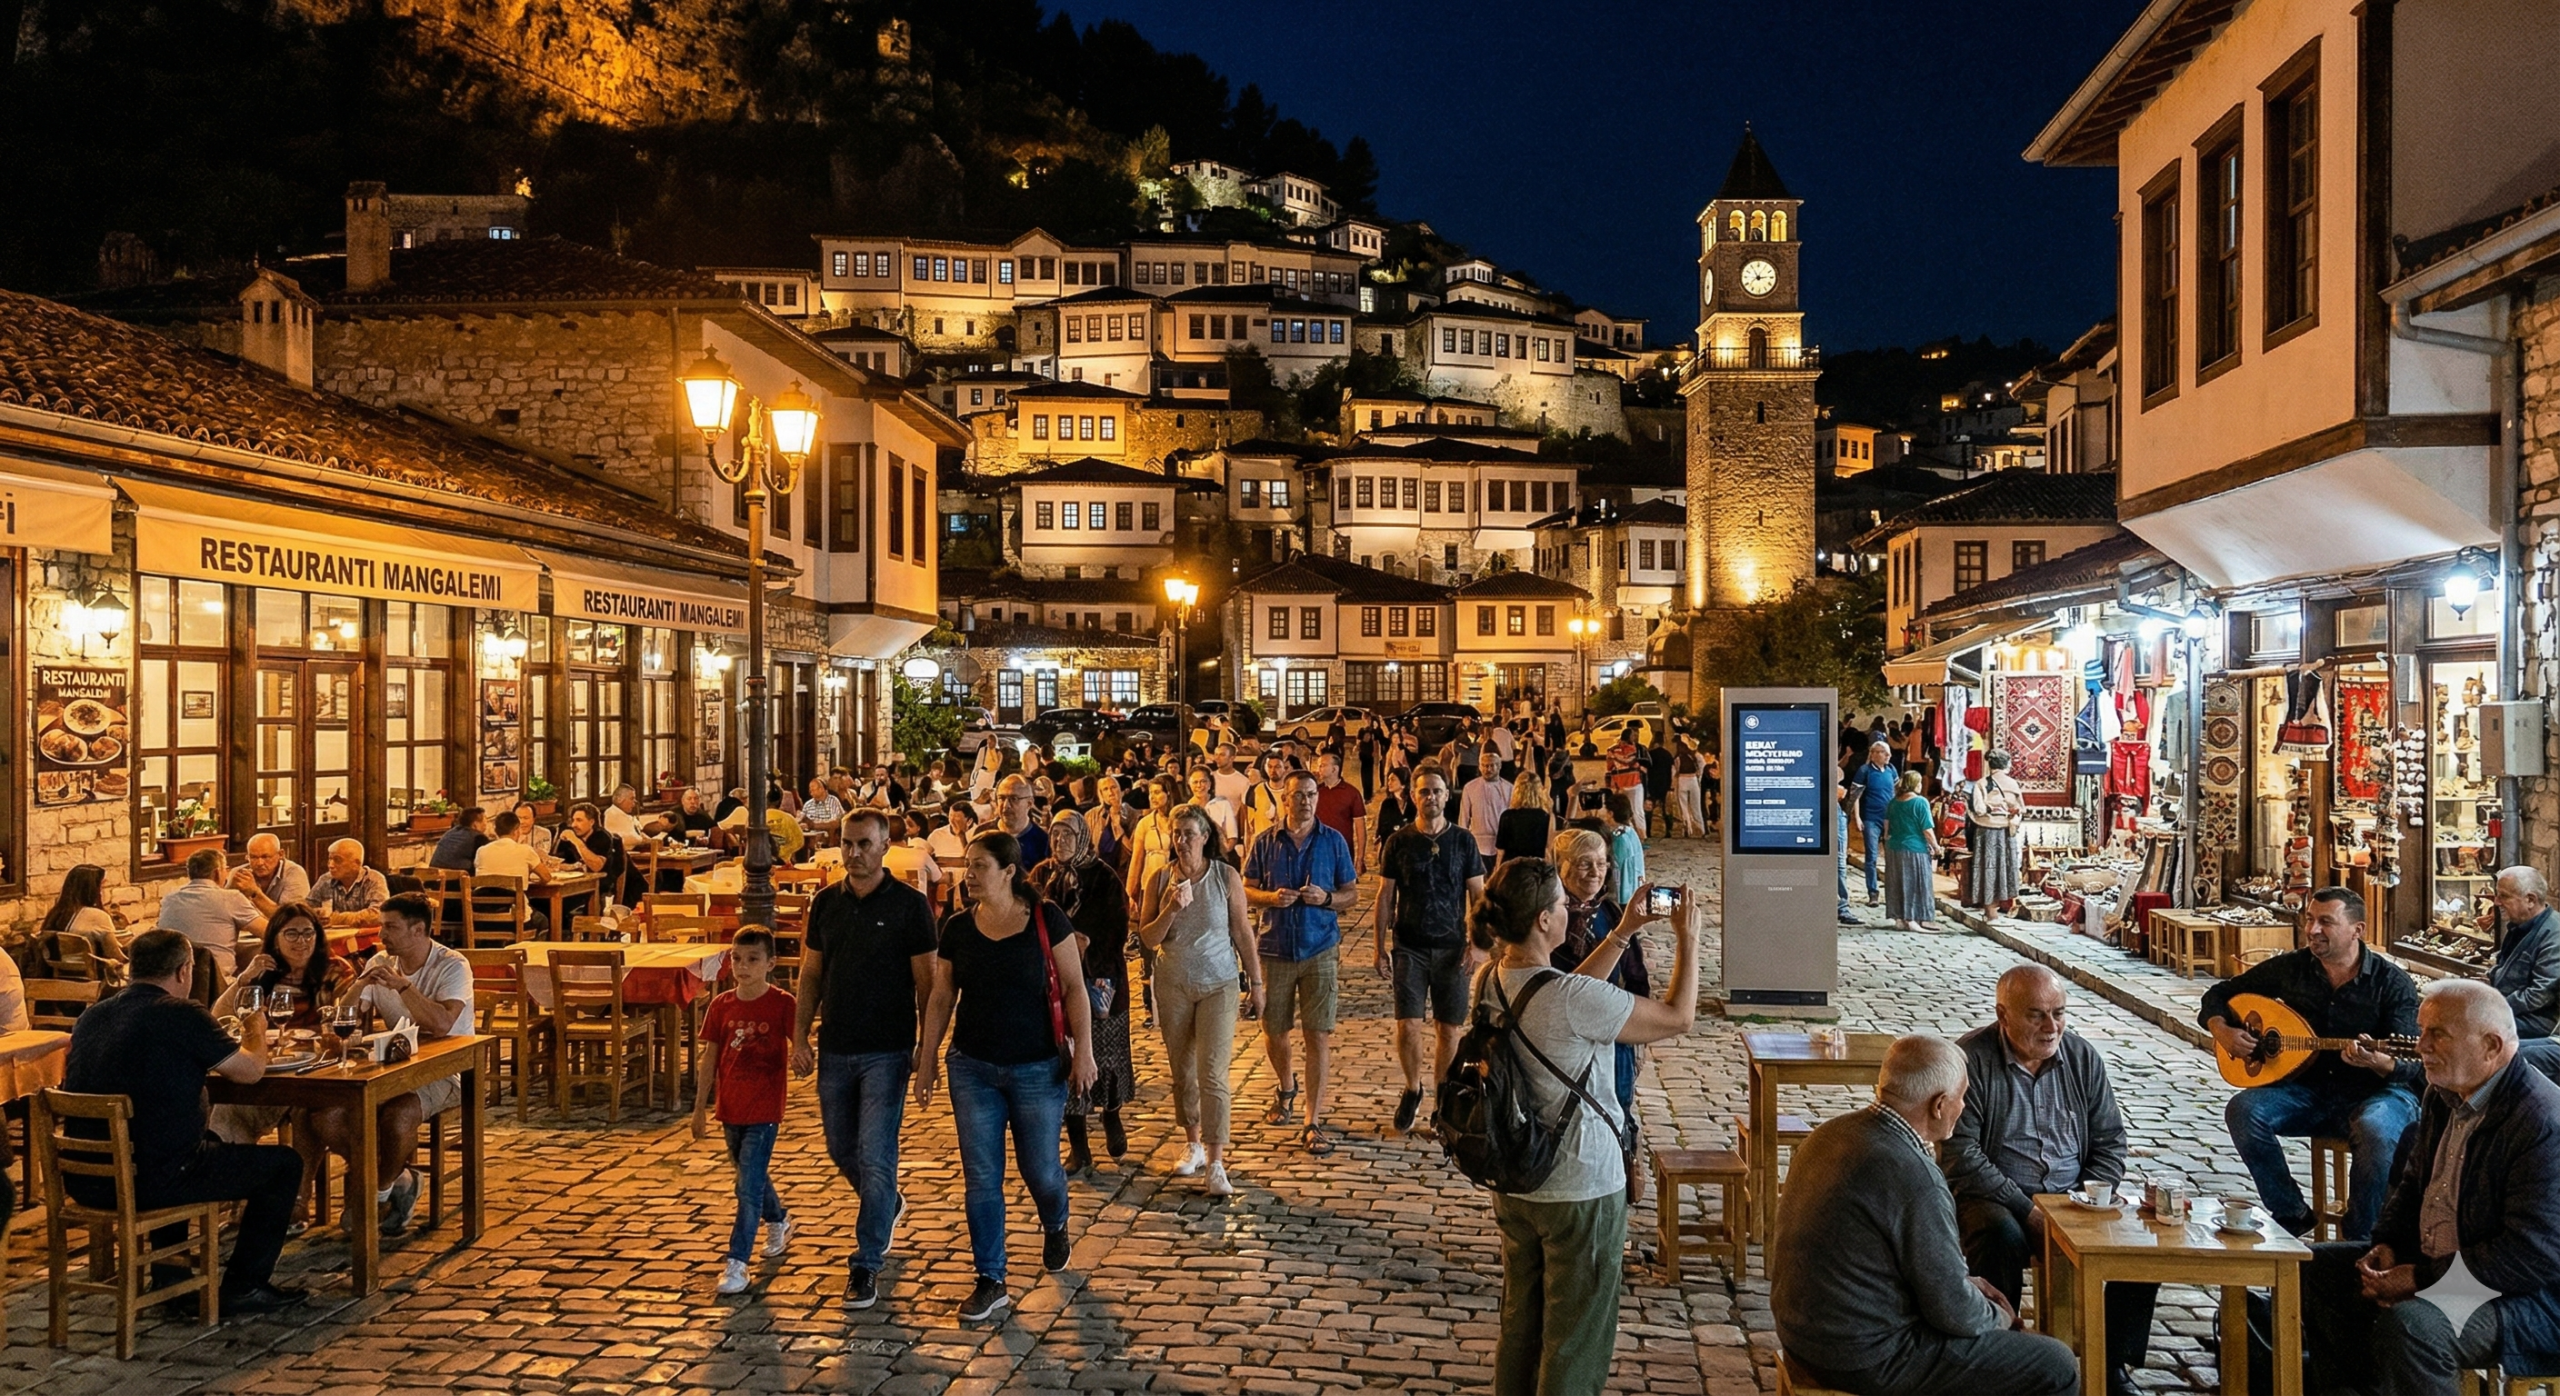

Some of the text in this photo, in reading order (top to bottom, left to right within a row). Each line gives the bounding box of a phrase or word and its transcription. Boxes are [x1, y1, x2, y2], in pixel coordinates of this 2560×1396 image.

[201, 537, 501, 602] RESTAURANTI MANGALEMI
[584, 590, 744, 629] RESTAURANTI MANGALEMI
[42, 670, 125, 687] RESTAURANTI
